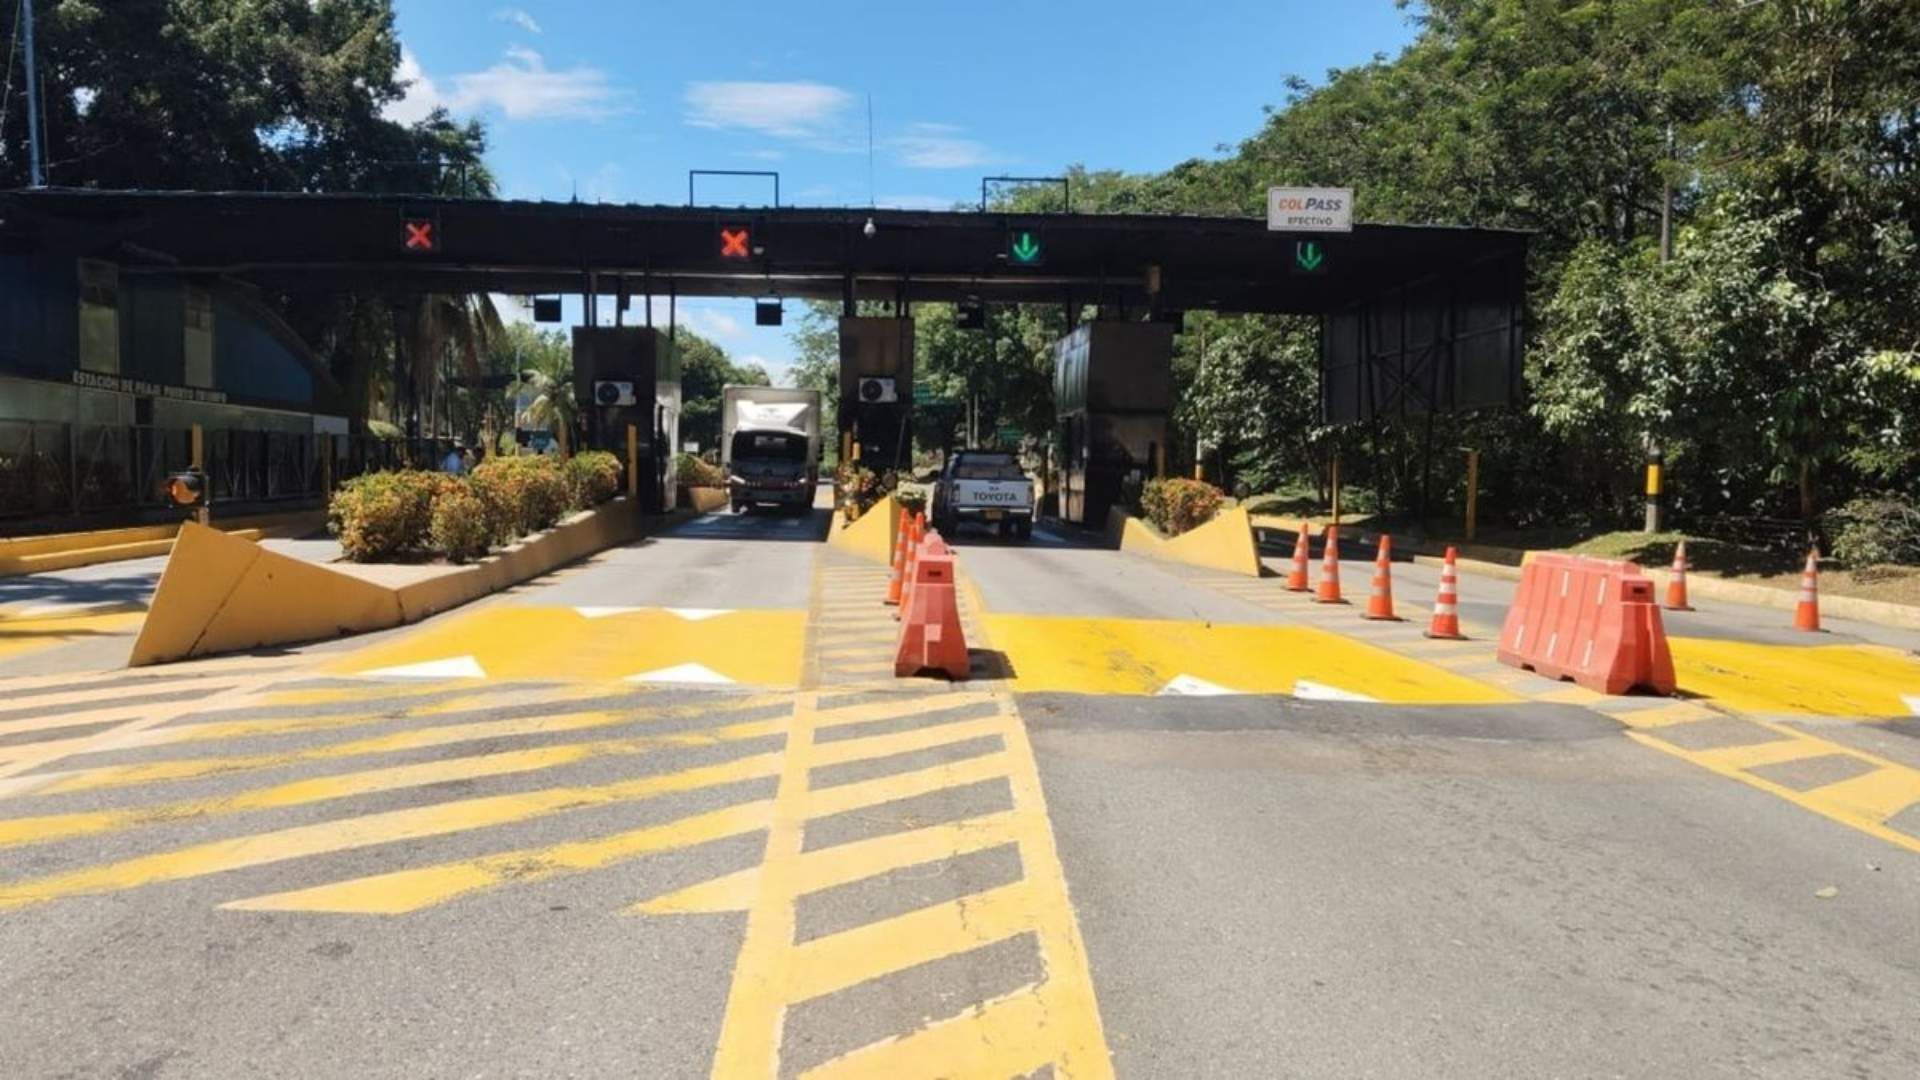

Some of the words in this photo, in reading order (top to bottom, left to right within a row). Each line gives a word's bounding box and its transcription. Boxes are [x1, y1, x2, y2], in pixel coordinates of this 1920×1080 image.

[1279, 197, 1343, 211] COLPASS
[1287, 216, 1334, 225] EFECTIVO
[973, 492, 1017, 501] TOYOTA
